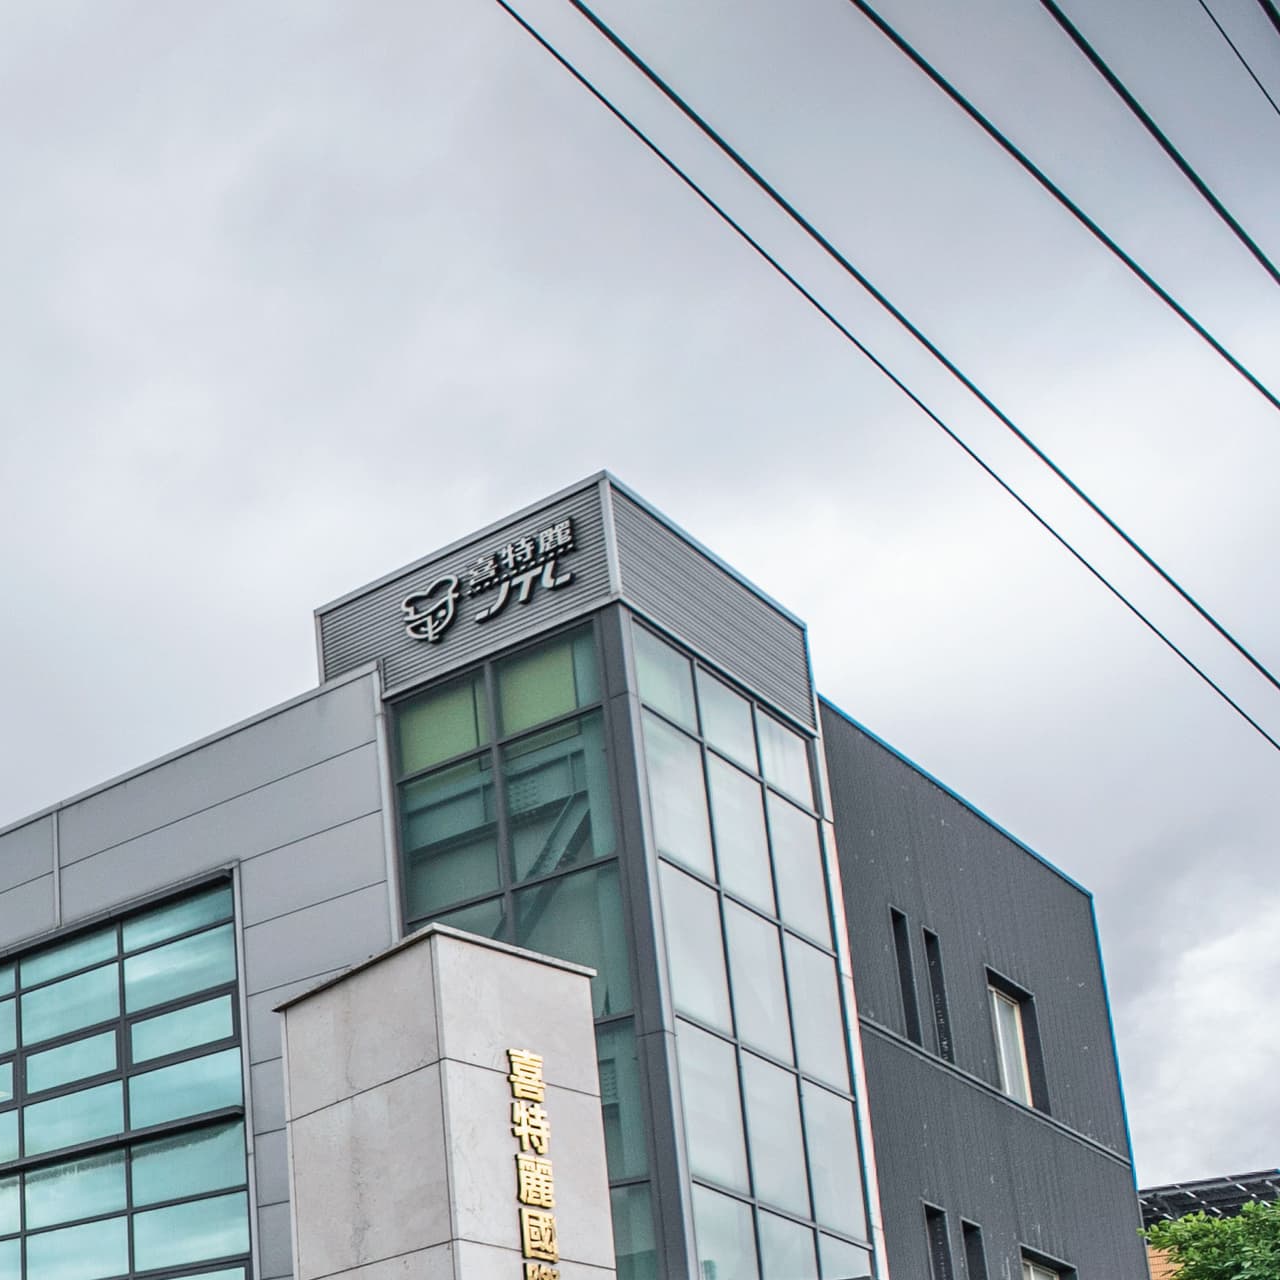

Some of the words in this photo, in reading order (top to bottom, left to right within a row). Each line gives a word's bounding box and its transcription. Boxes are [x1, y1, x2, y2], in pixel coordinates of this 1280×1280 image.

[466, 517, 574, 588] 喜特麗
[474, 560, 574, 622] JTL
